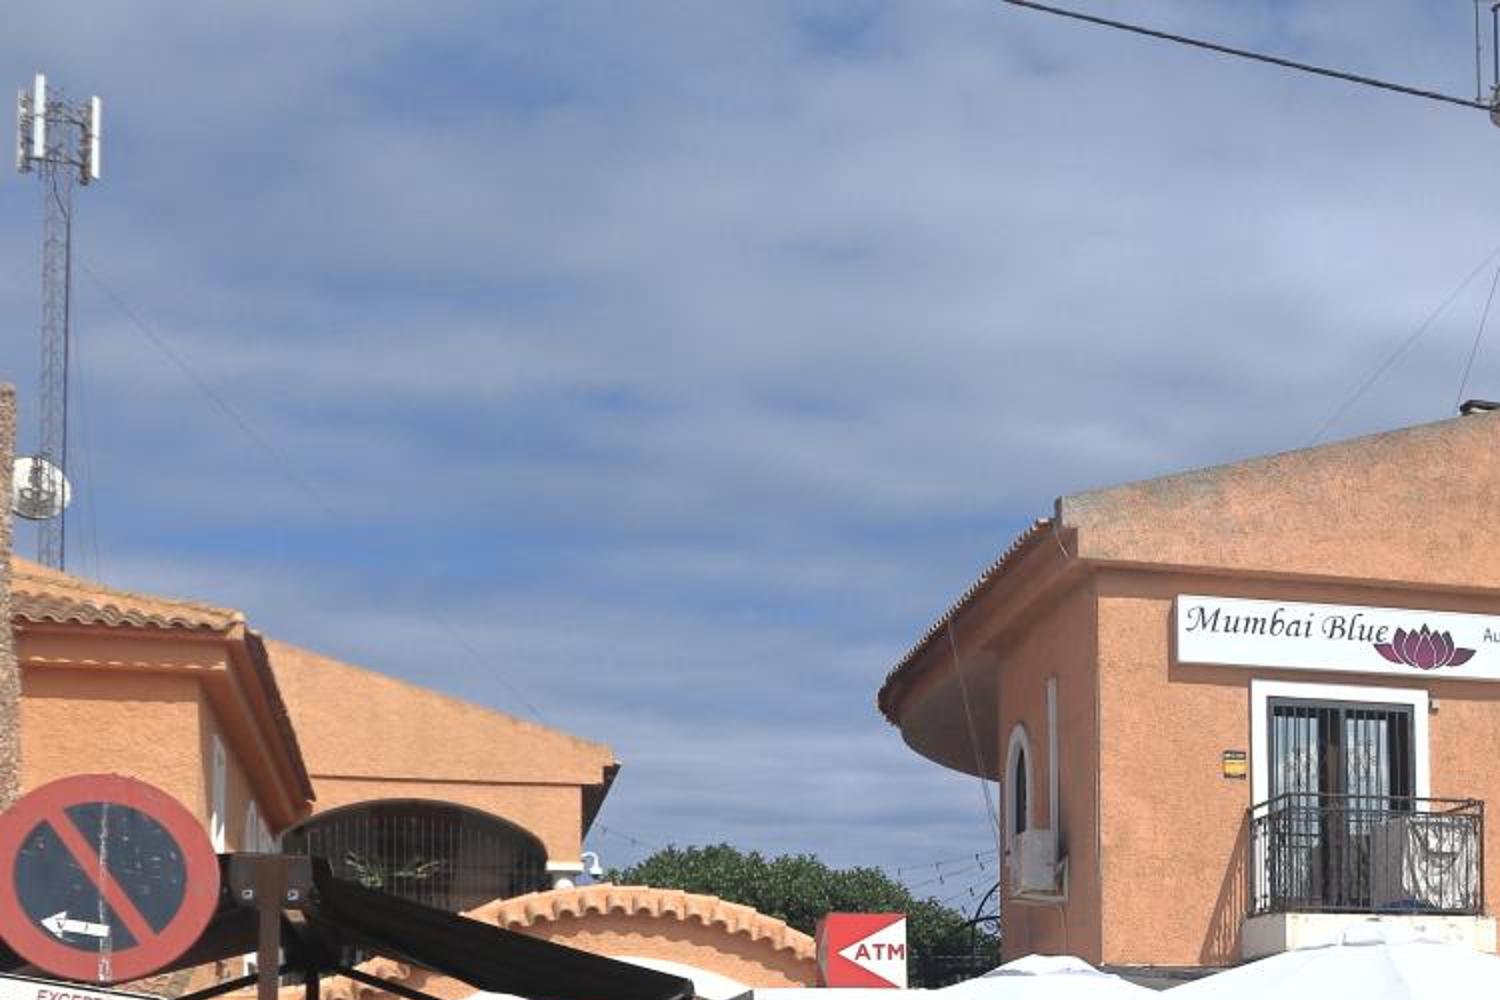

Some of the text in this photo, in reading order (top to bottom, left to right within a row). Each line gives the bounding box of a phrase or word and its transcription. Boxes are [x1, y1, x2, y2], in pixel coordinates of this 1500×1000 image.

[1185, 605, 1389, 643] Mumbai Blue
[854, 943, 906, 961] ATM
